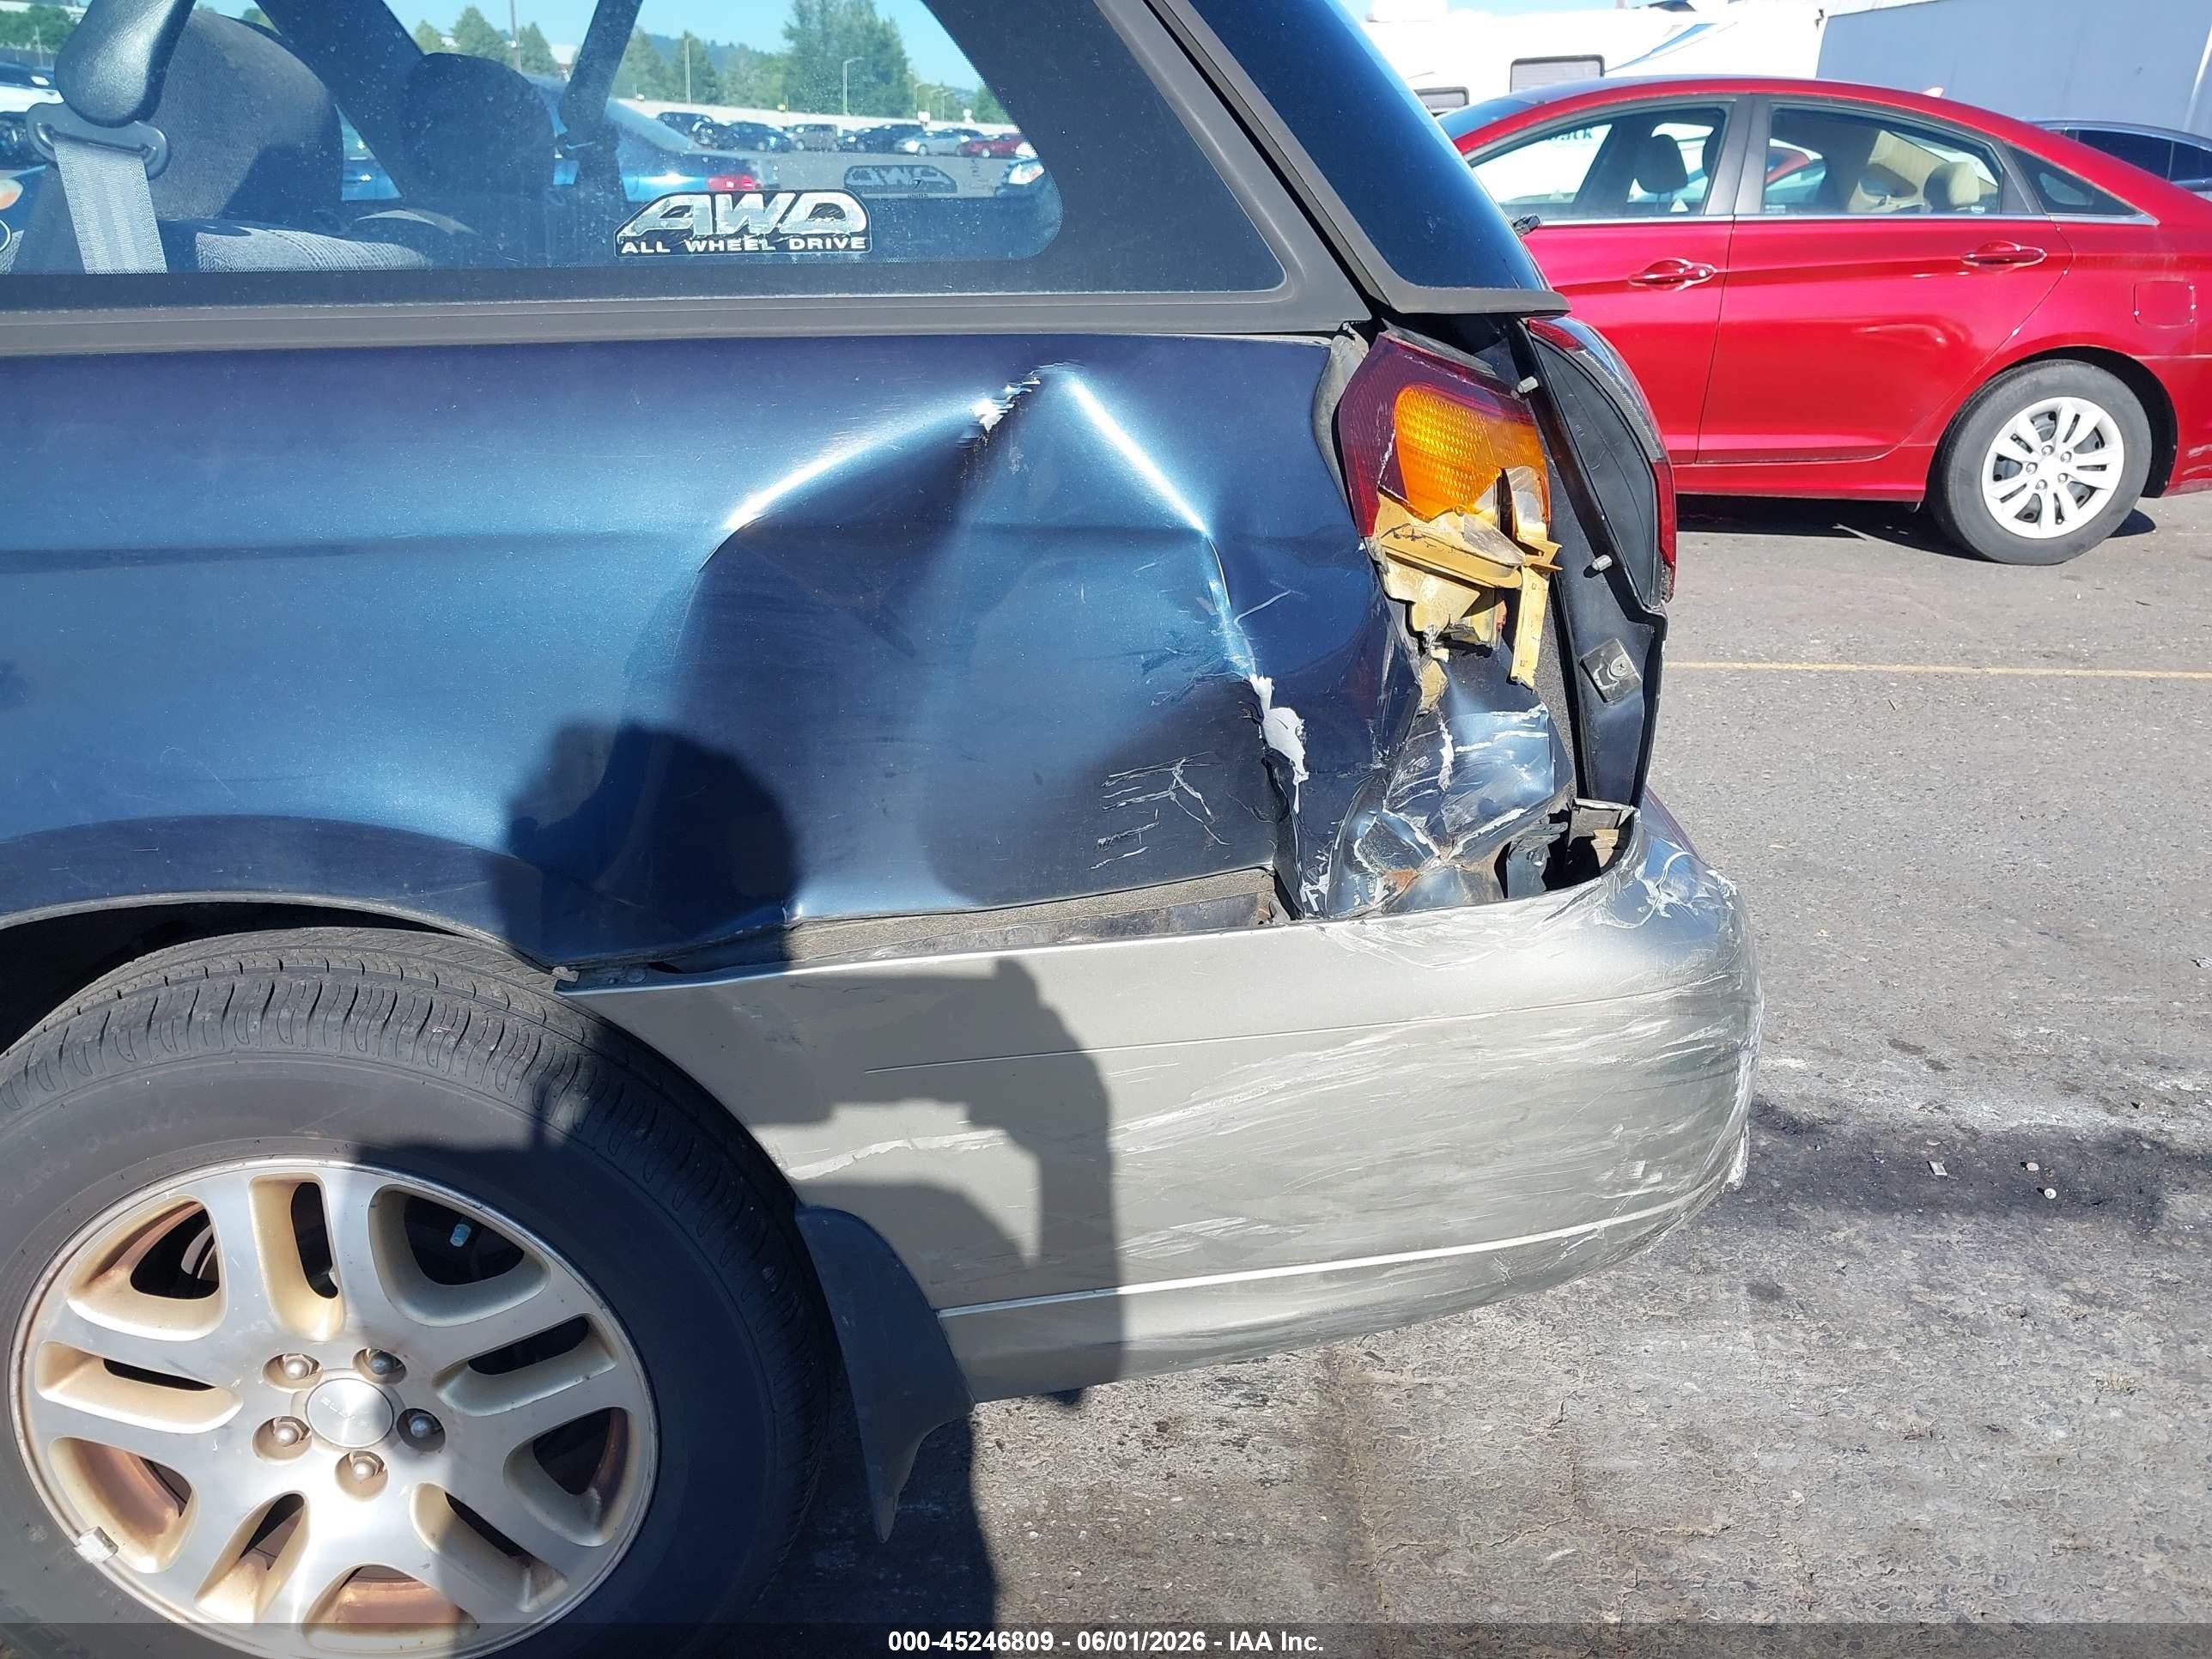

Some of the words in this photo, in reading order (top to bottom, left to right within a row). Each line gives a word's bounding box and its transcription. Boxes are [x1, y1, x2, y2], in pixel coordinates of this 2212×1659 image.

[617, 192, 867, 239] AWD
[622, 241, 671, 253] ALL
[685, 239, 776, 252] WHEEL
[788, 237, 866, 250] DRIVE
